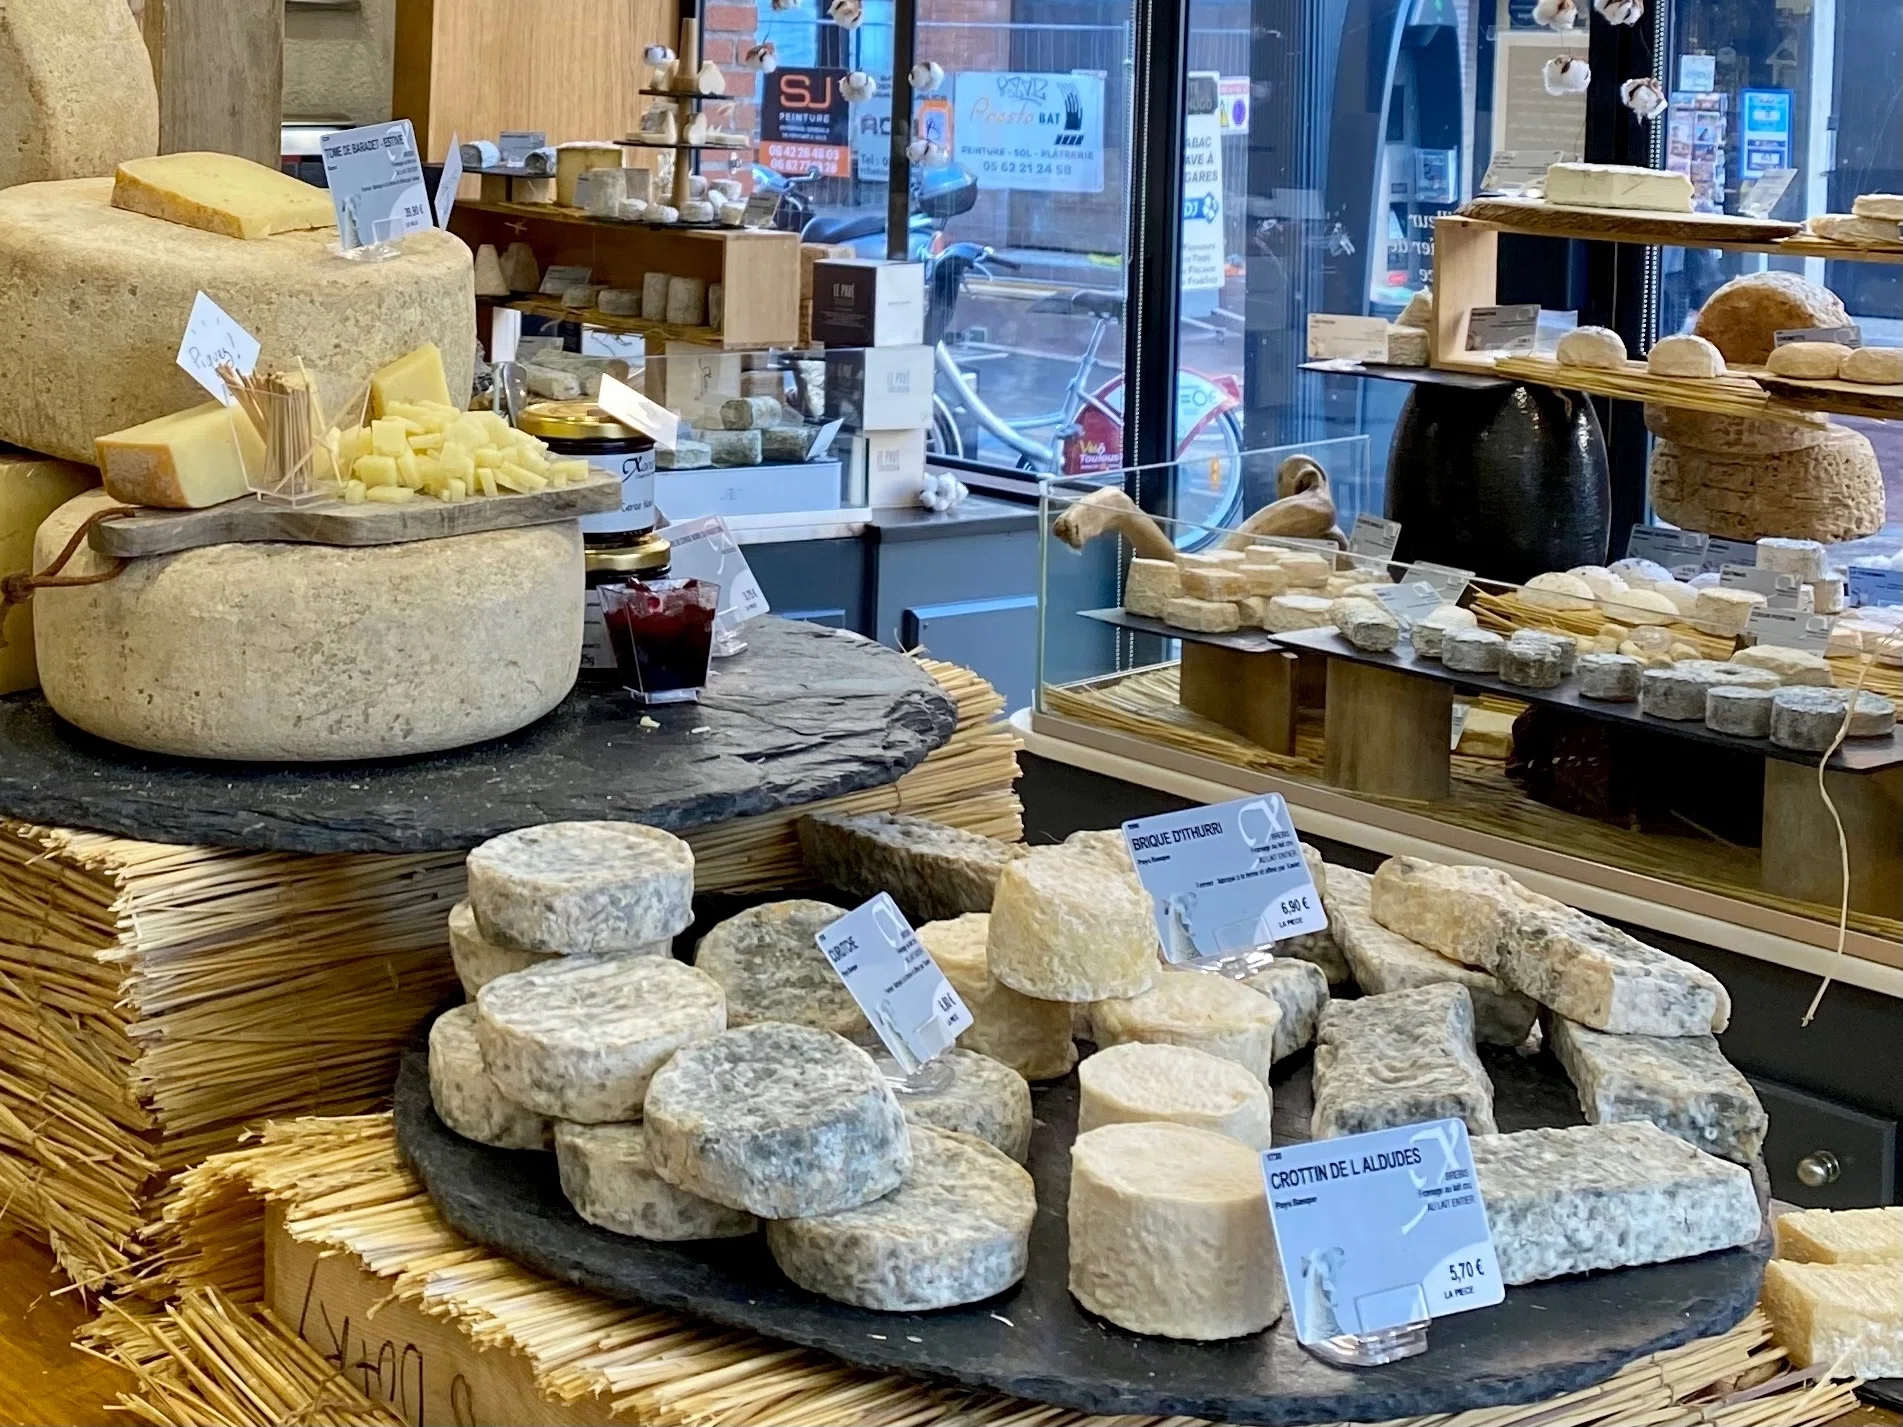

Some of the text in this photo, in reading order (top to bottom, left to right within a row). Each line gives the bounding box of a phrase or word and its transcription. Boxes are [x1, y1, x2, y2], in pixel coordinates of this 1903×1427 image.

[780, 74, 832, 109] SJ
[779, 112, 830, 124] PEINTURE
[1038, 112, 1061, 125] BAT
[1186, 136, 1212, 148] ABAC
[1014, 148, 1032, 158] SOL
[1186, 152, 1205, 166] AVE
[983, 161, 998, 172] 05
[1185, 170, 1219, 183] GARES
[1132, 821, 1223, 851] BRIQUE D'ITHURRI
[1280, 896, 1311, 916] 6,90 €
[1271, 1164, 1329, 1190] CROTTIN
[1331, 1159, 1350, 1180] DE
[1362, 1147, 1422, 1174] ALDUDES
[1449, 1258, 1485, 1284] 5,70 €
[1443, 1290, 1455, 1300] LA
